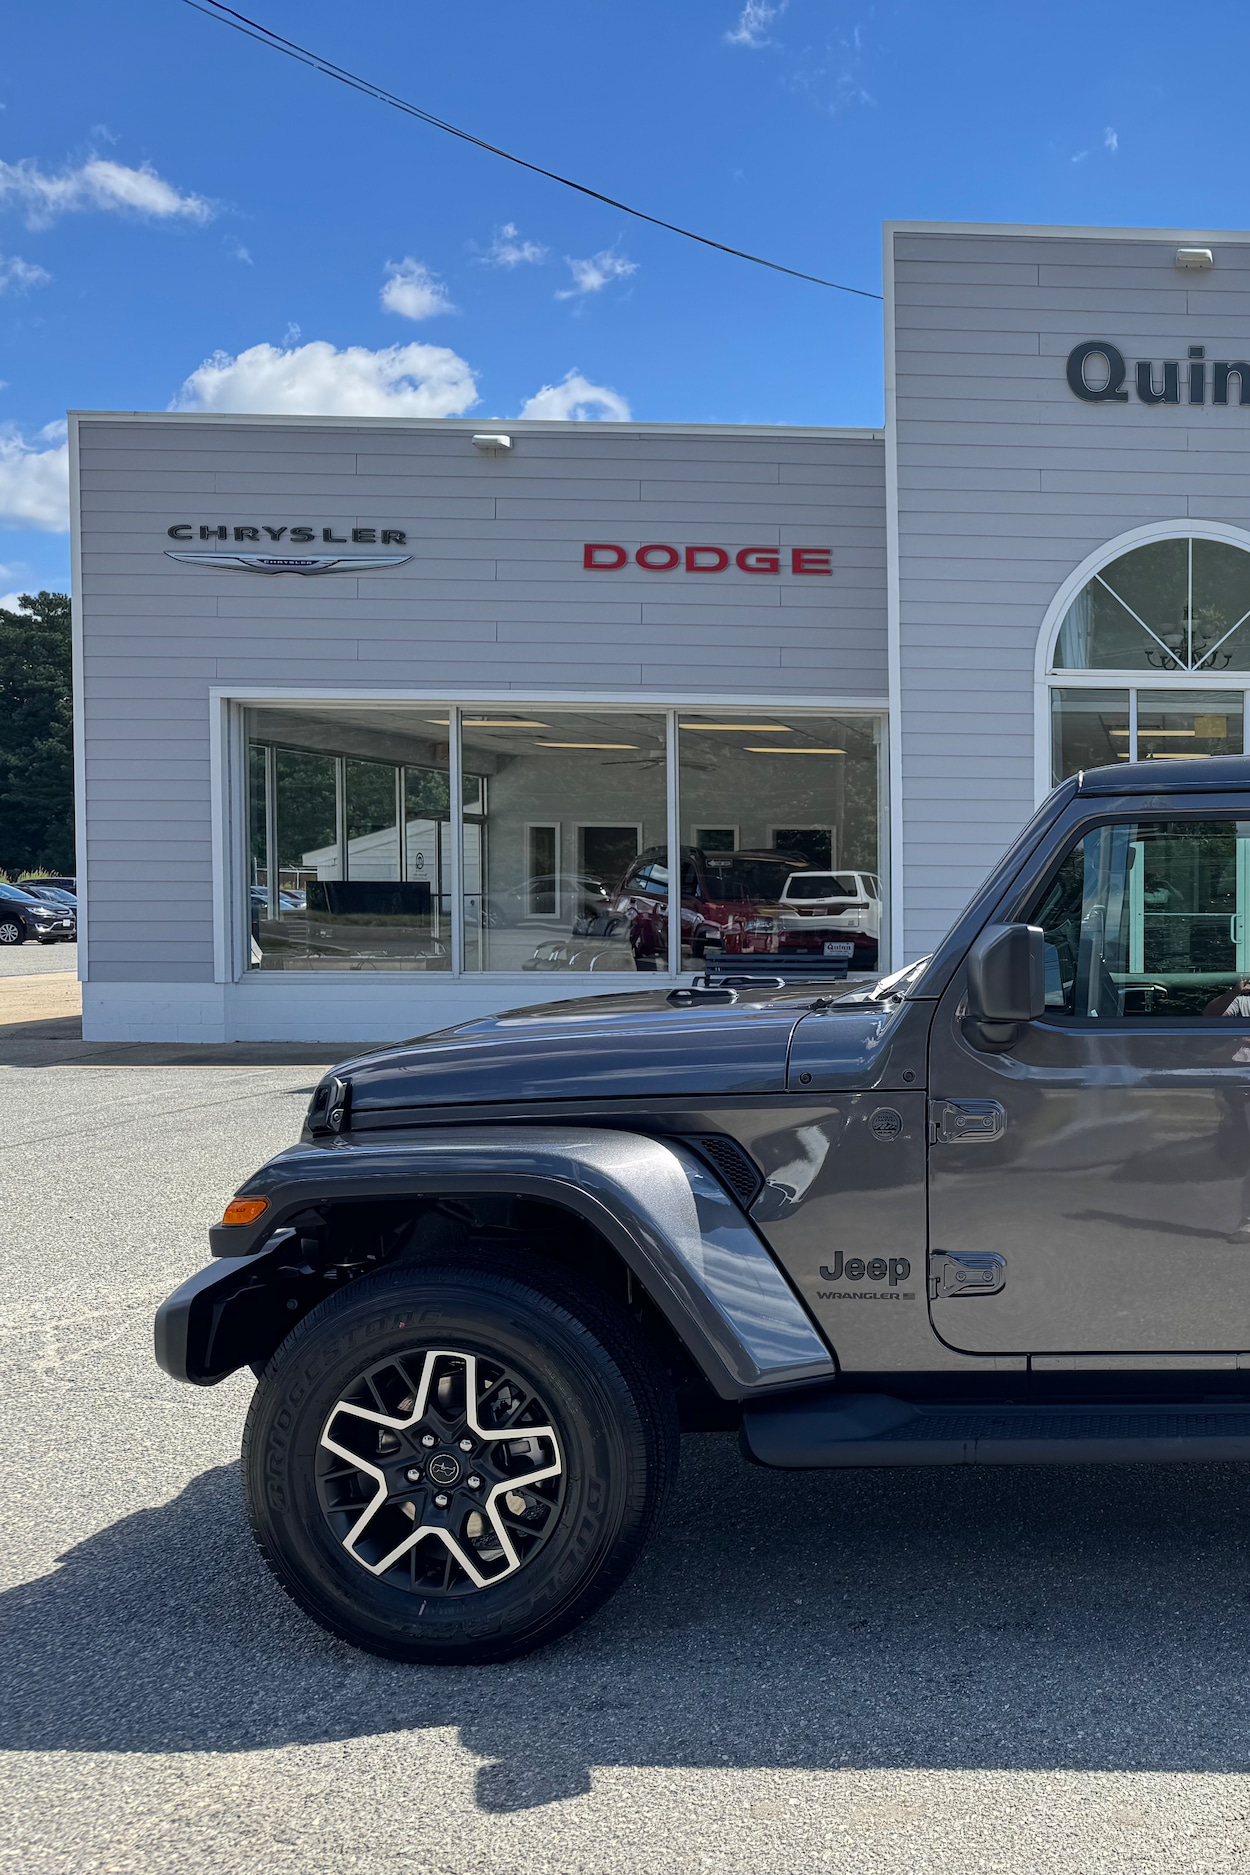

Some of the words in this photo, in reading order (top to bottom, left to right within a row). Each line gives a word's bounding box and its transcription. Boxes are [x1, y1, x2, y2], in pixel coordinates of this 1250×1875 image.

[168, 524, 406, 545] CHRYSLER
[584, 543, 833, 576] DODGE
[819, 1250, 911, 1286] Jeep
[816, 1291, 900, 1300] WRANGLER
[266, 1306, 444, 1514] BRIDGESTONE
